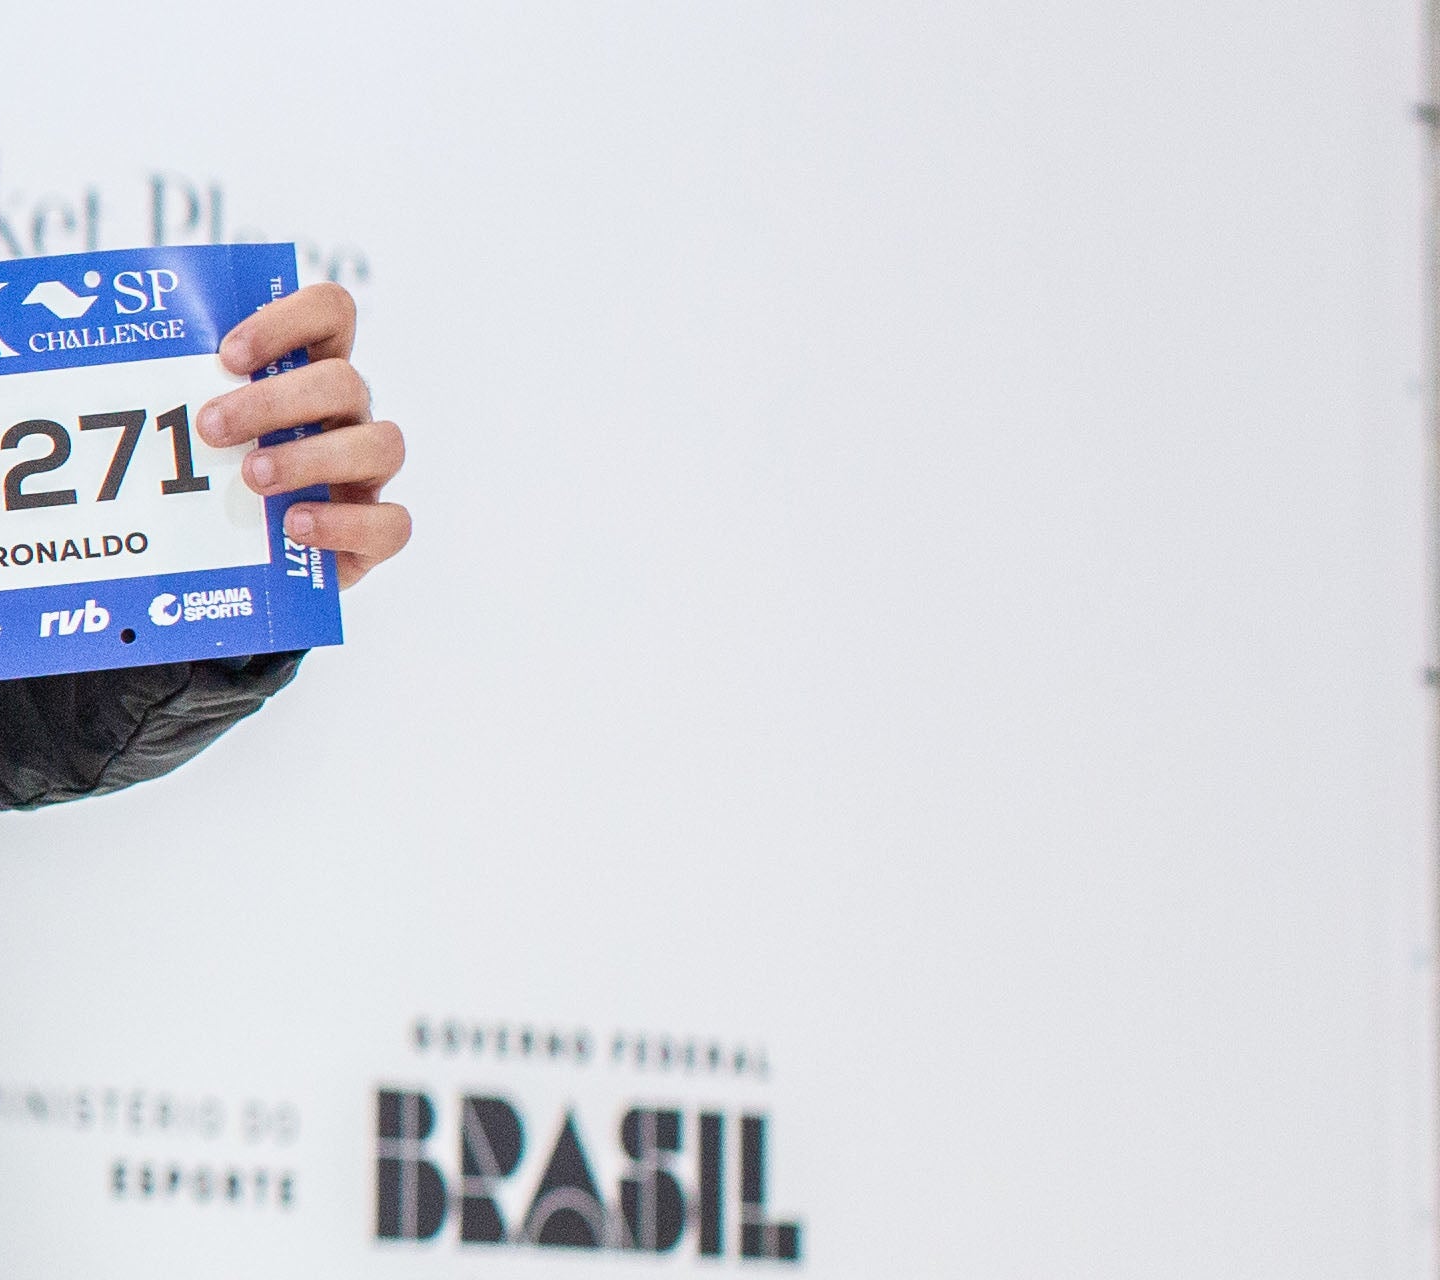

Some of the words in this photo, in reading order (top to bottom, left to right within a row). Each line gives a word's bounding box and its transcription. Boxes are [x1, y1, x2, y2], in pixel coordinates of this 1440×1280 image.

[112, 269, 182, 316] SP
[28, 318, 186, 354] CHALLENGE
[282, 526, 309, 578] 271
[39, 599, 111, 638] rvb
[182, 586, 253, 608] IGUANA
[183, 601, 254, 623] SPORTS
[412, 1016, 596, 1066] GOVERNO
[610, 1029, 773, 1080] FEDERAL
[110, 1159, 298, 1210] ESPORTE
[372, 1082, 806, 1265] BRASIL
